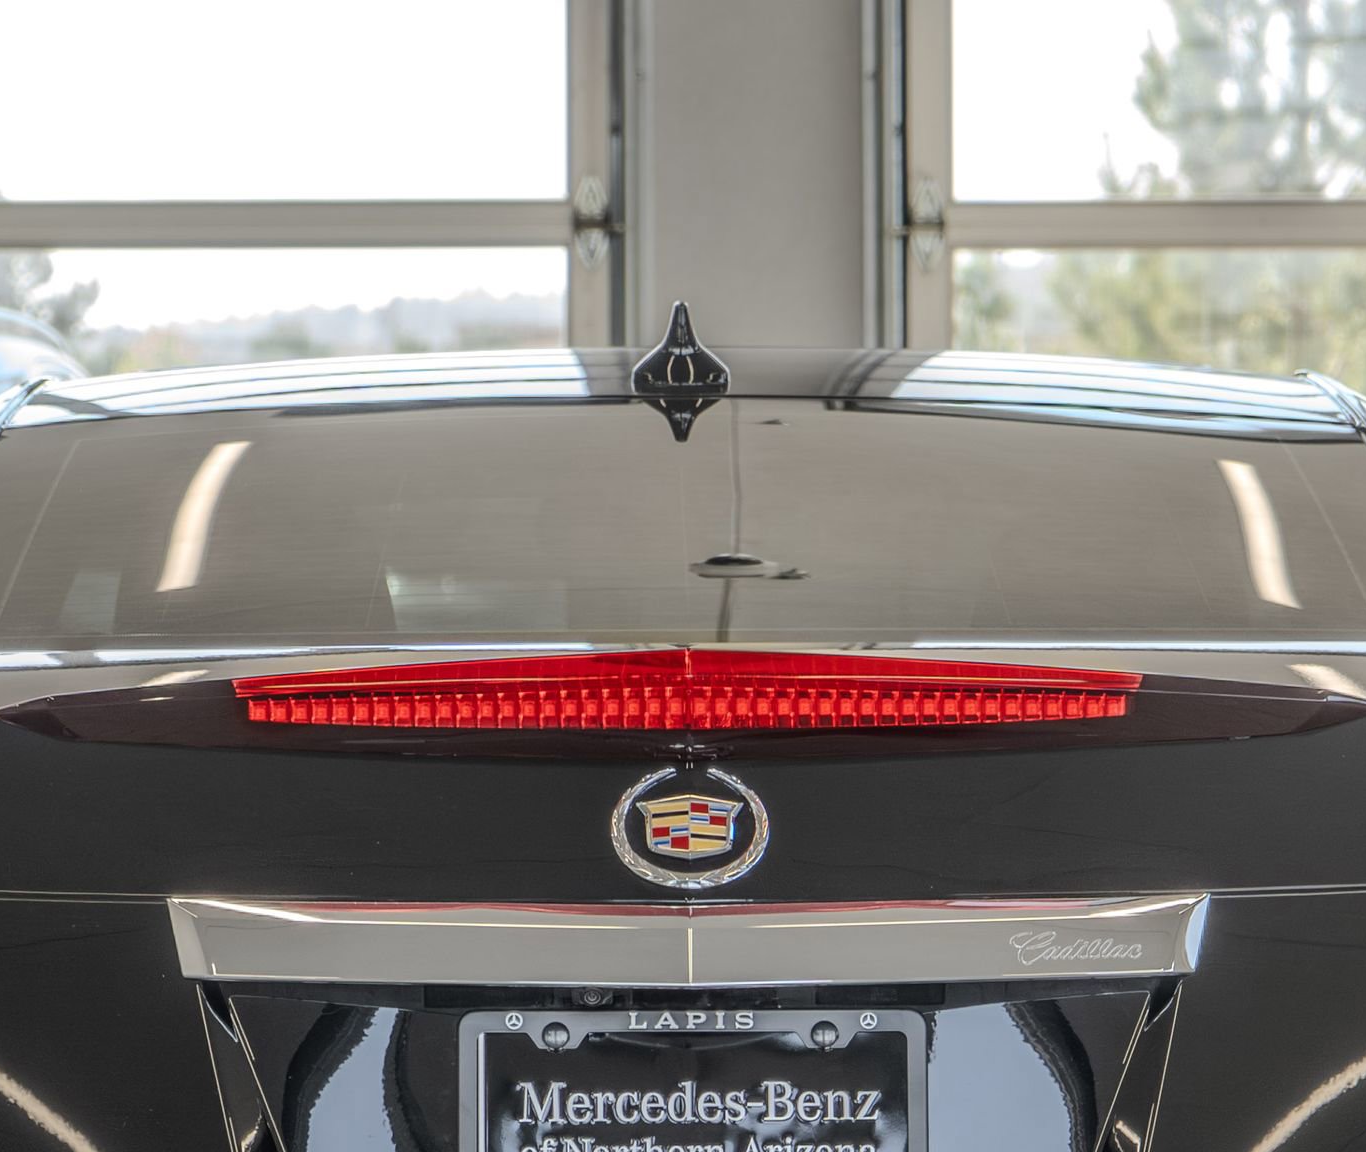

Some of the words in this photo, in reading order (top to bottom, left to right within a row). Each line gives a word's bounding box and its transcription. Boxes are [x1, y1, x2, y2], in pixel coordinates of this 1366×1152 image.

[1009, 931, 1143, 966] Cadillac
[628, 1012, 755, 1030] LAPIS
[515, 1080, 882, 1125] Mercedes-Benz
